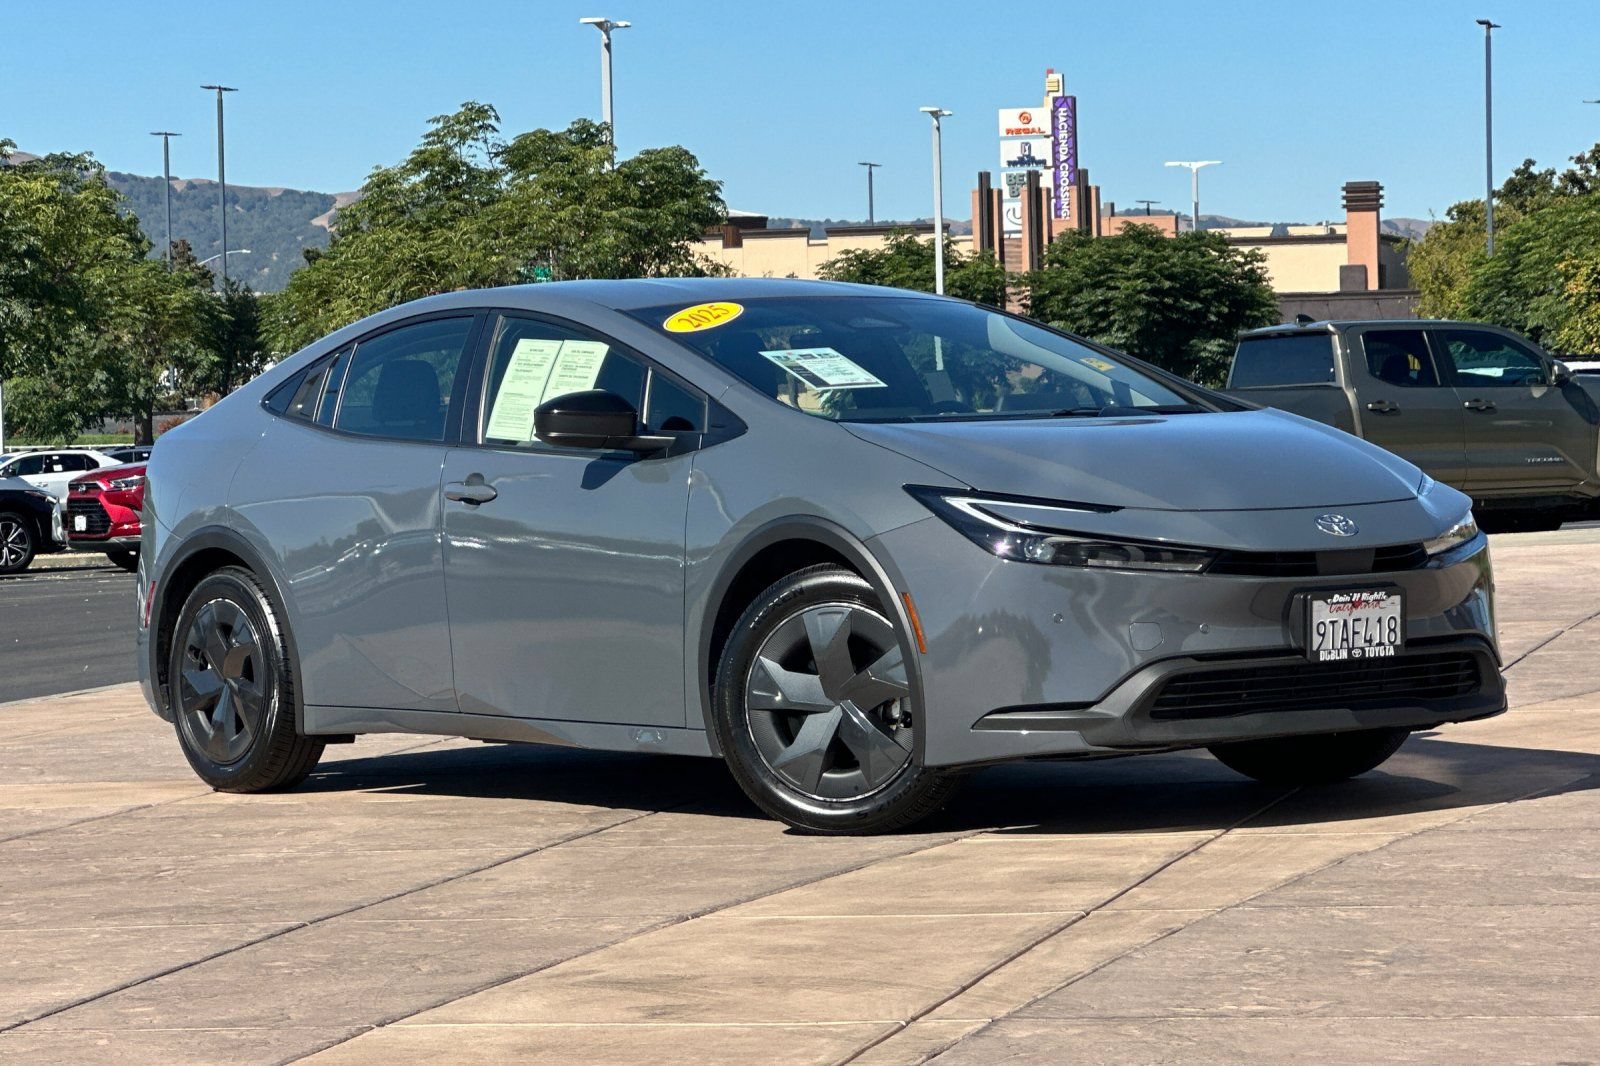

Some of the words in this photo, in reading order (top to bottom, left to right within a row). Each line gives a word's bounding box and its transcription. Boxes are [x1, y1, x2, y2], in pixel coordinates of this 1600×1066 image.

[1005, 127, 1046, 135] REGAL
[1058, 107, 1069, 162] HACIENDA
[678, 305, 730, 328] 2025
[1316, 615, 1397, 651] 9TAF418
[1319, 648, 1348, 661] DUBLIN
[1365, 645, 1395, 658] TOYOTA
